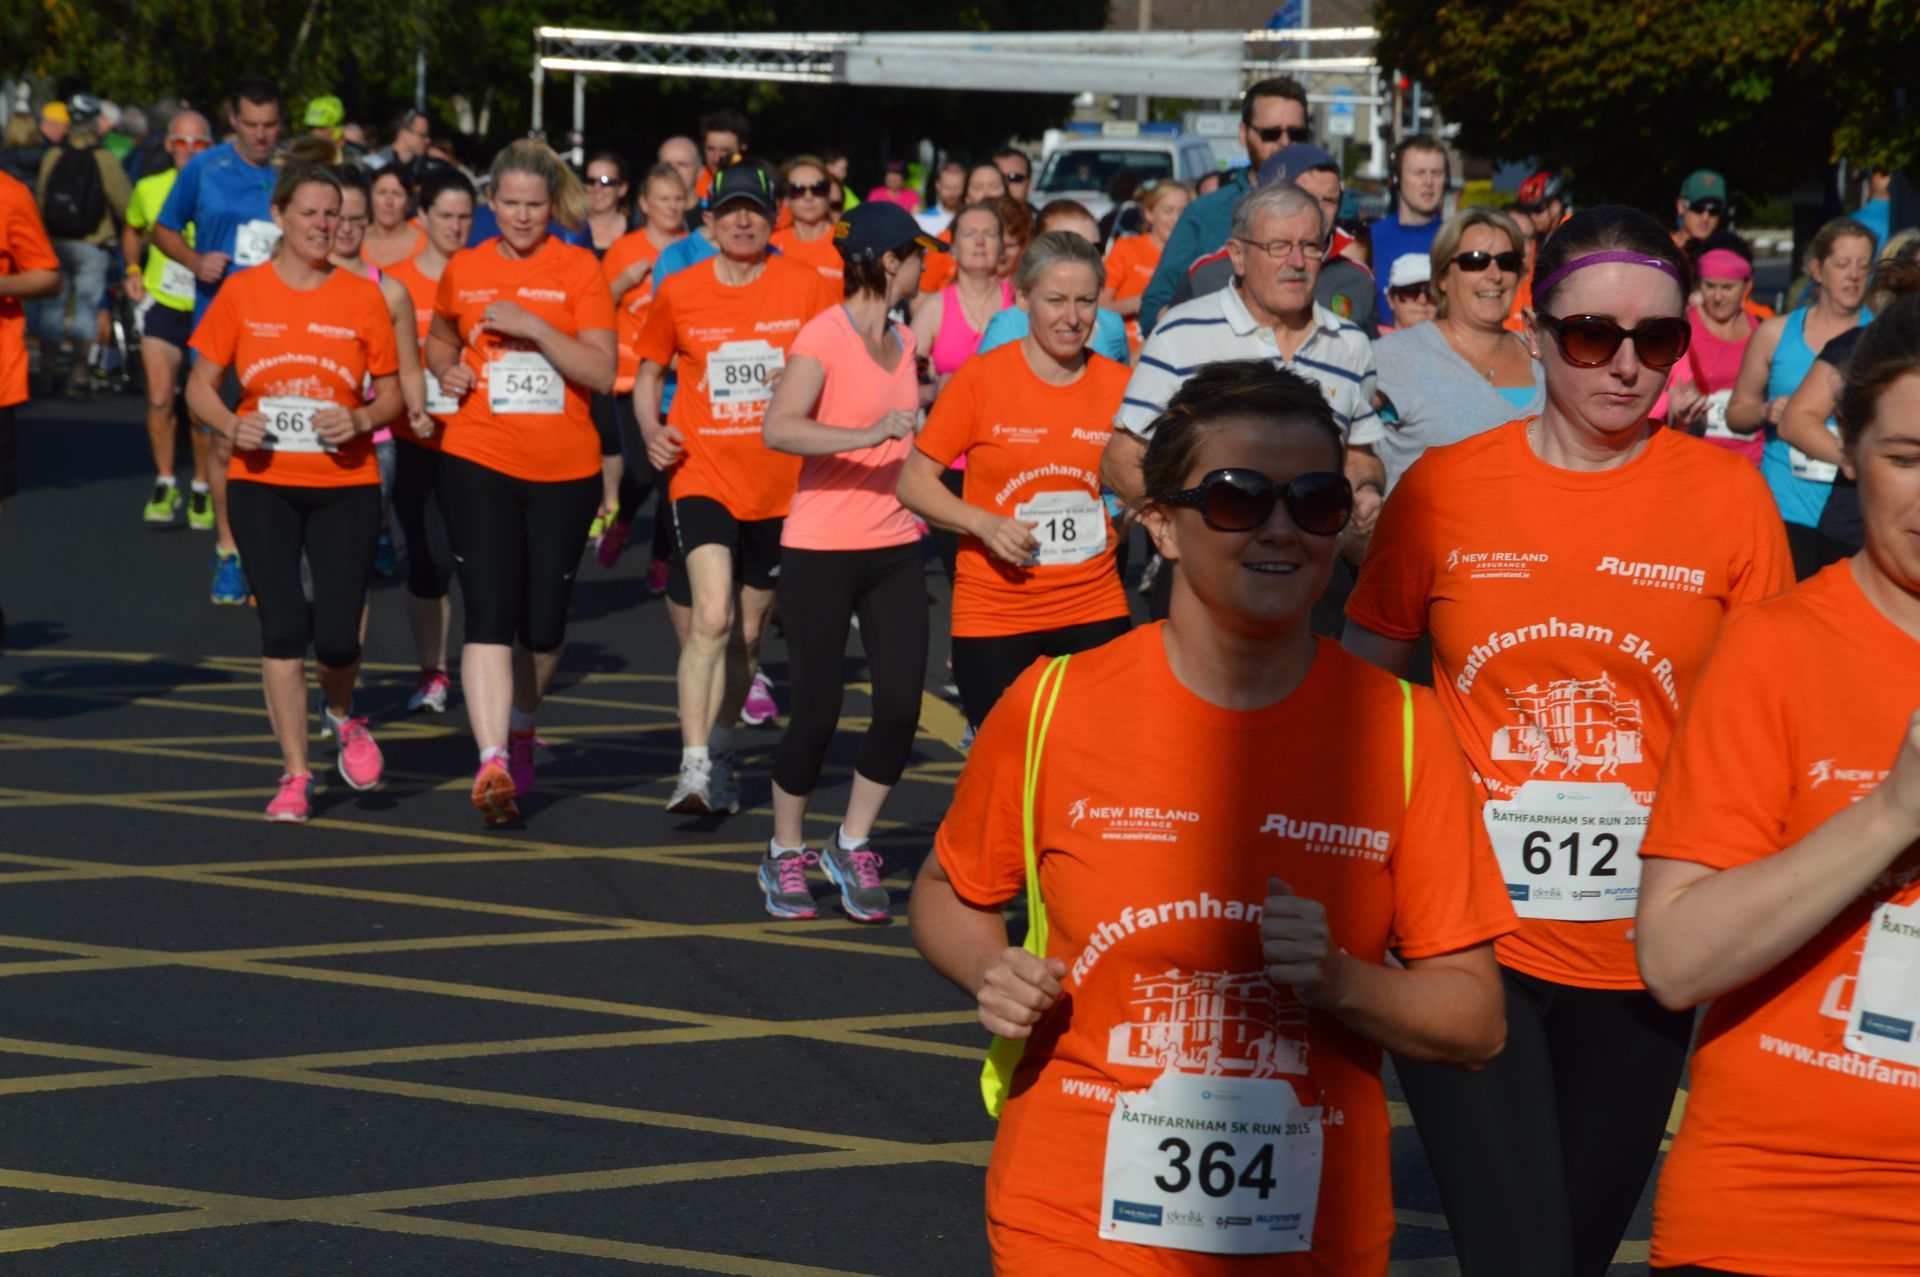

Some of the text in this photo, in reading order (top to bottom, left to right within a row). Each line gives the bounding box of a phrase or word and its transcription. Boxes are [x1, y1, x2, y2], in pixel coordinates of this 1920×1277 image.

[505, 374, 549, 395] 542
[725, 363, 766, 385] 890
[995, 463, 1082, 507] Rathfarnham
[1045, 517, 1077, 542] 18
[1461, 552, 1549, 563] NEW IRELAND
[1632, 578, 1703, 595] SUPERSTORE
[1456, 616, 1613, 696] Rathfarnham
[1618, 633, 1656, 665] 5k
[1834, 769, 1875, 781] NEW
[1089, 807, 1200, 823] NEW IRELAND
[1109, 820, 1173, 829] ASSURANCE
[1493, 812, 1649, 826] RATHFARNHAM 5K RUN 2015
[1101, 832, 1178, 842] www.newireland.ie
[1305, 842, 1386, 863] SUPERSTORE
[1522, 830, 1619, 877] 612
[1121, 1110, 1311, 1136] RATHFARNHAM 5K RUN 2015
[1154, 1136, 1277, 1199] 364
